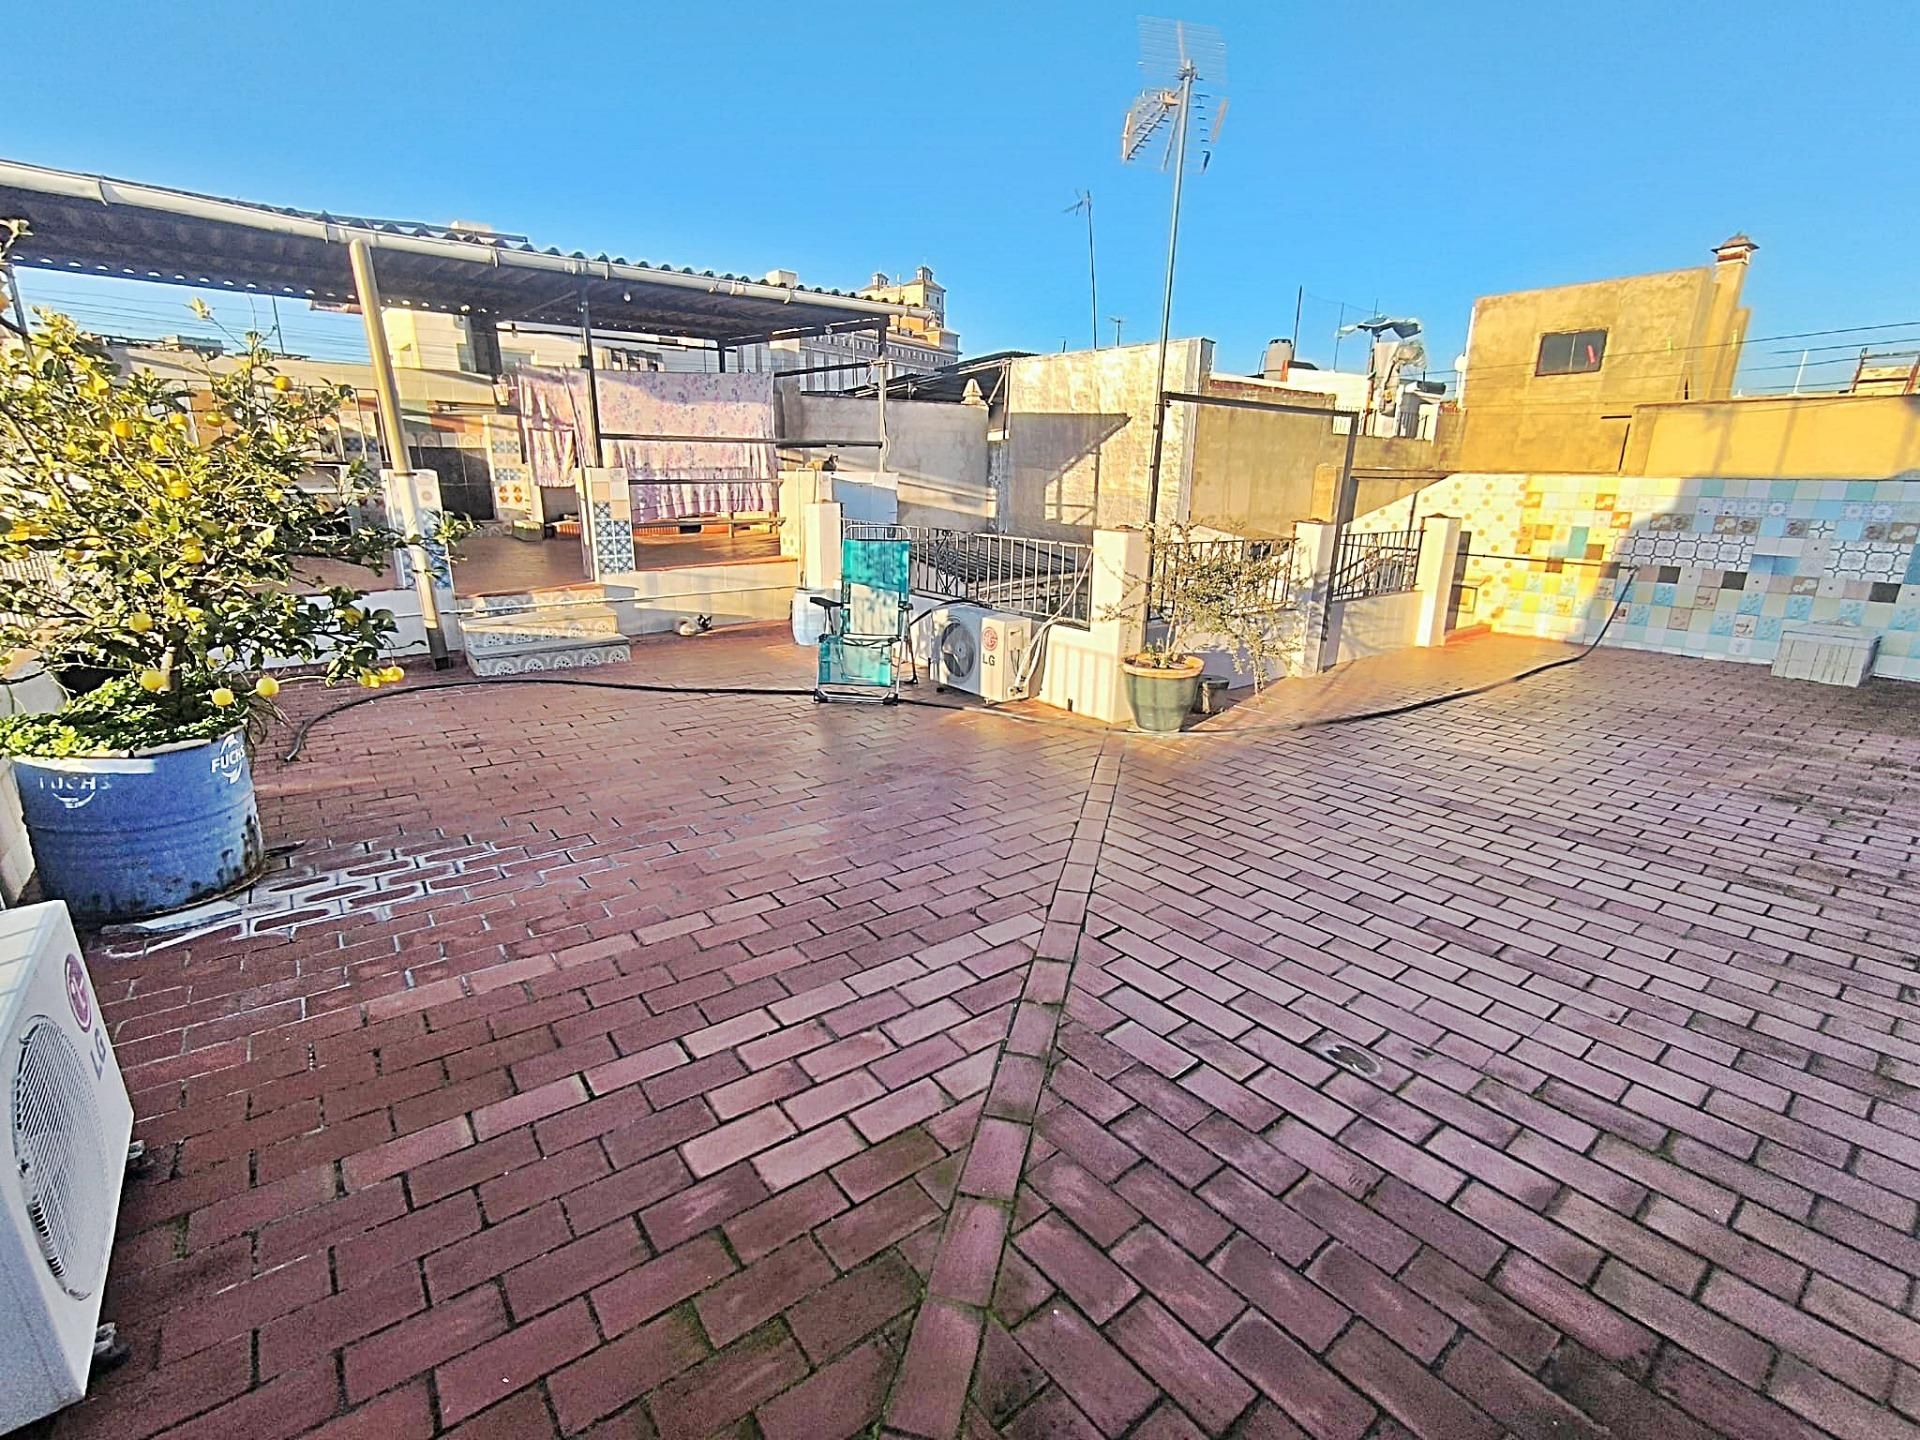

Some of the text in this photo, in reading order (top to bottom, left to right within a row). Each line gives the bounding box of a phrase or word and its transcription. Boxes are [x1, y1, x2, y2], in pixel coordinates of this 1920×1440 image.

[982, 653, 996, 667] LG
[211, 744, 246, 774] FUCHS
[90, 1028, 106, 1081] LG
